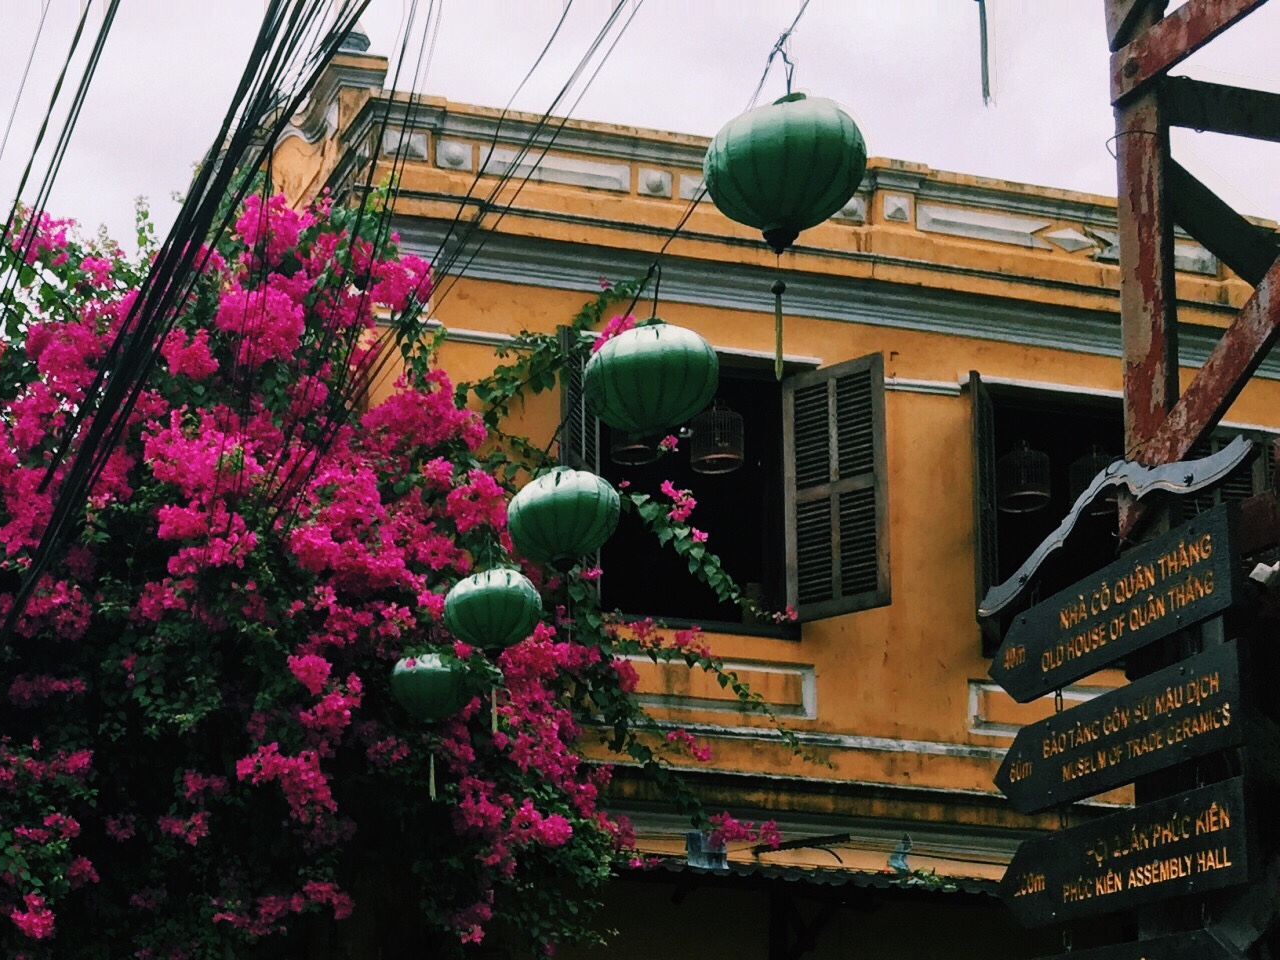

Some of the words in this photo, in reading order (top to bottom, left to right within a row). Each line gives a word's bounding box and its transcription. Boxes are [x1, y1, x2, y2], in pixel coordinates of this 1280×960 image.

[1041, 644, 1064, 672] OLD
[1067, 622, 1107, 660] HOUSE
[1109, 613, 1125, 640] OF
[1062, 750, 1107, 782] MUSEUM
[1126, 730, 1162, 759] TRADE
[1166, 702, 1232, 746] CERAMICS
[1128, 854, 1192, 889] ASSEMBLY
[1196, 846, 1232, 873] HALL
